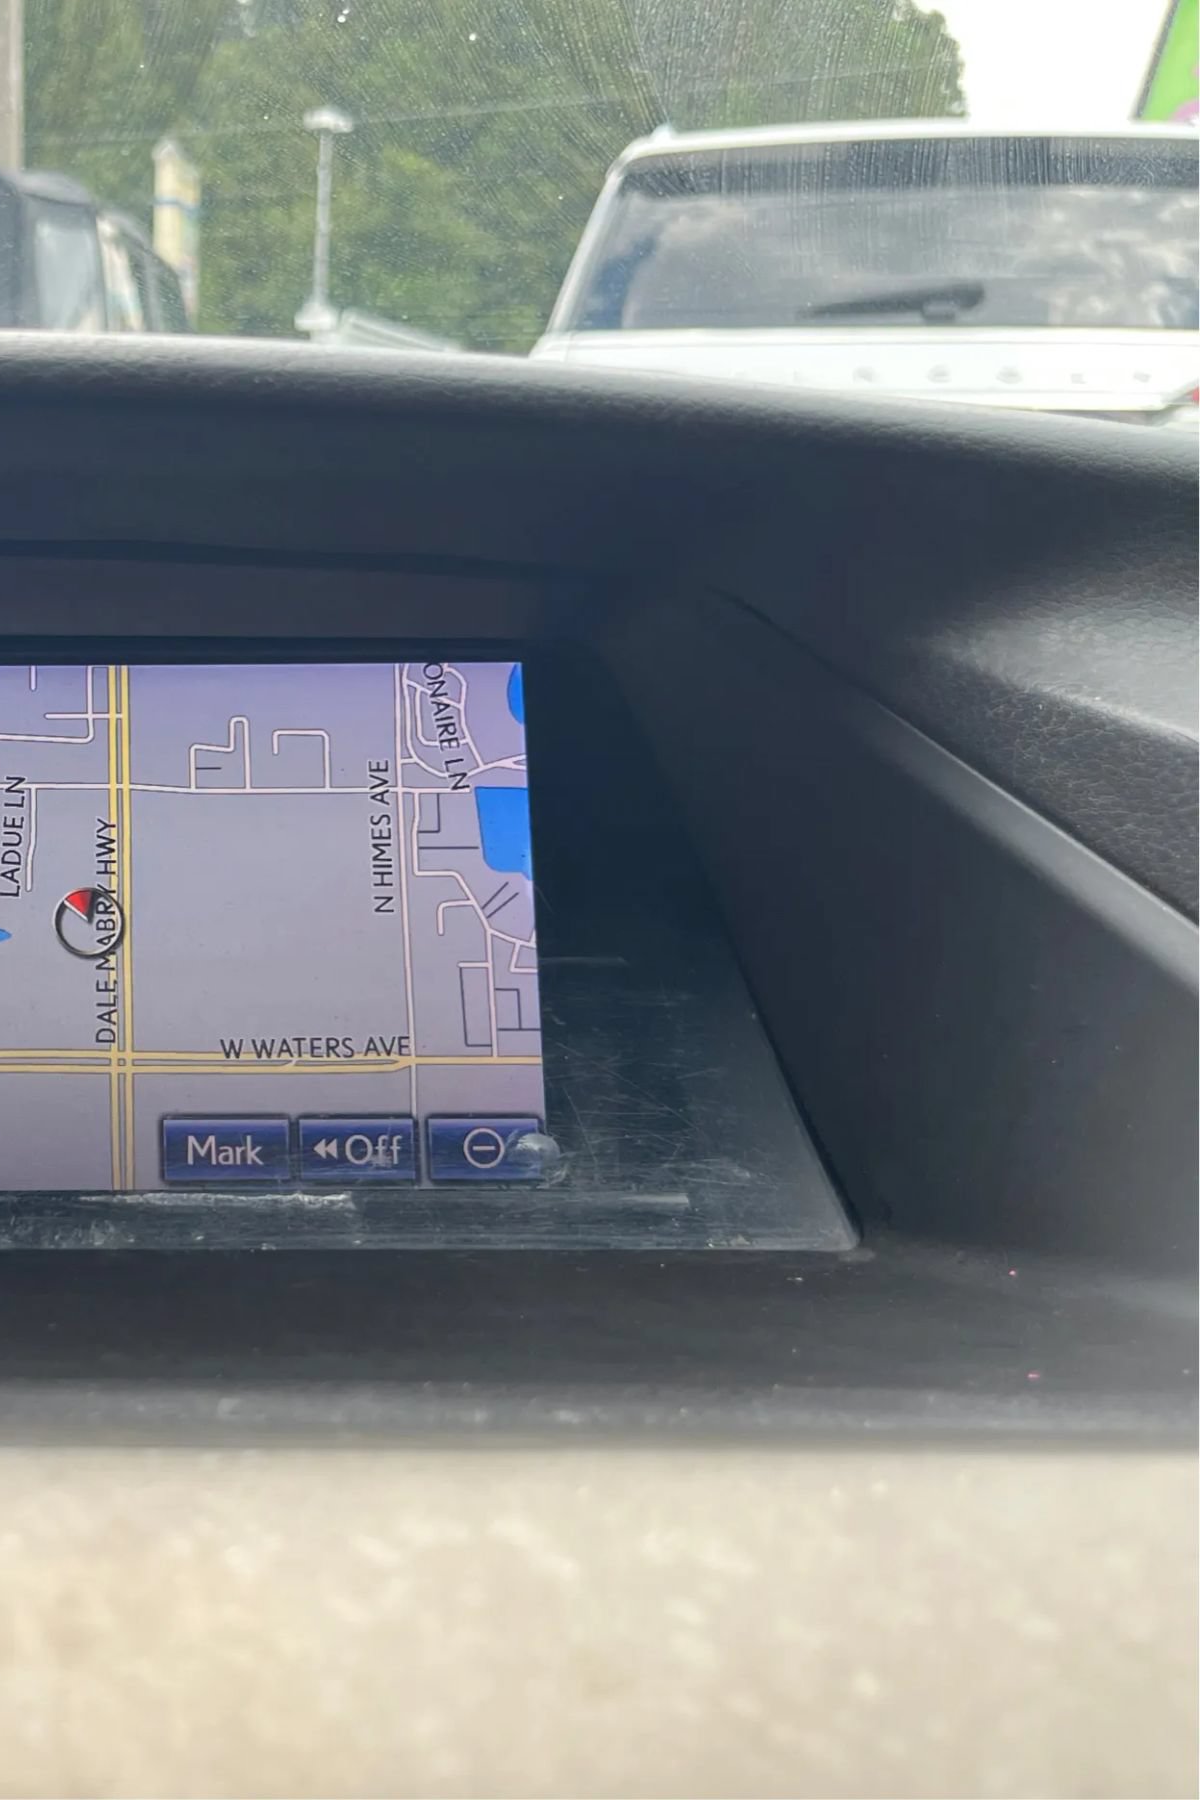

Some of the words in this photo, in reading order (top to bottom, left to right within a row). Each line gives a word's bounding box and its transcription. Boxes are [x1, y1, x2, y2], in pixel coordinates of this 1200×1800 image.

[423, 662, 461, 752] ONAIRE
[444, 758, 471, 791] LN
[4, 776, 26, 808] LN
[368, 760, 391, 806] AVE
[0, 816, 25, 897] LADUE
[95, 818, 117, 875] HWY
[370, 814, 393, 887] HIMES
[95, 883, 117, 970] MABRY
[373, 896, 395, 913] N
[95, 980, 118, 1044] DALE
[220, 1038, 243, 1059] W
[251, 1036, 354, 1059] WATERS
[363, 1035, 411, 1057] AVE
[187, 1134, 264, 1166] Mark
[344, 1134, 403, 1165] Off
